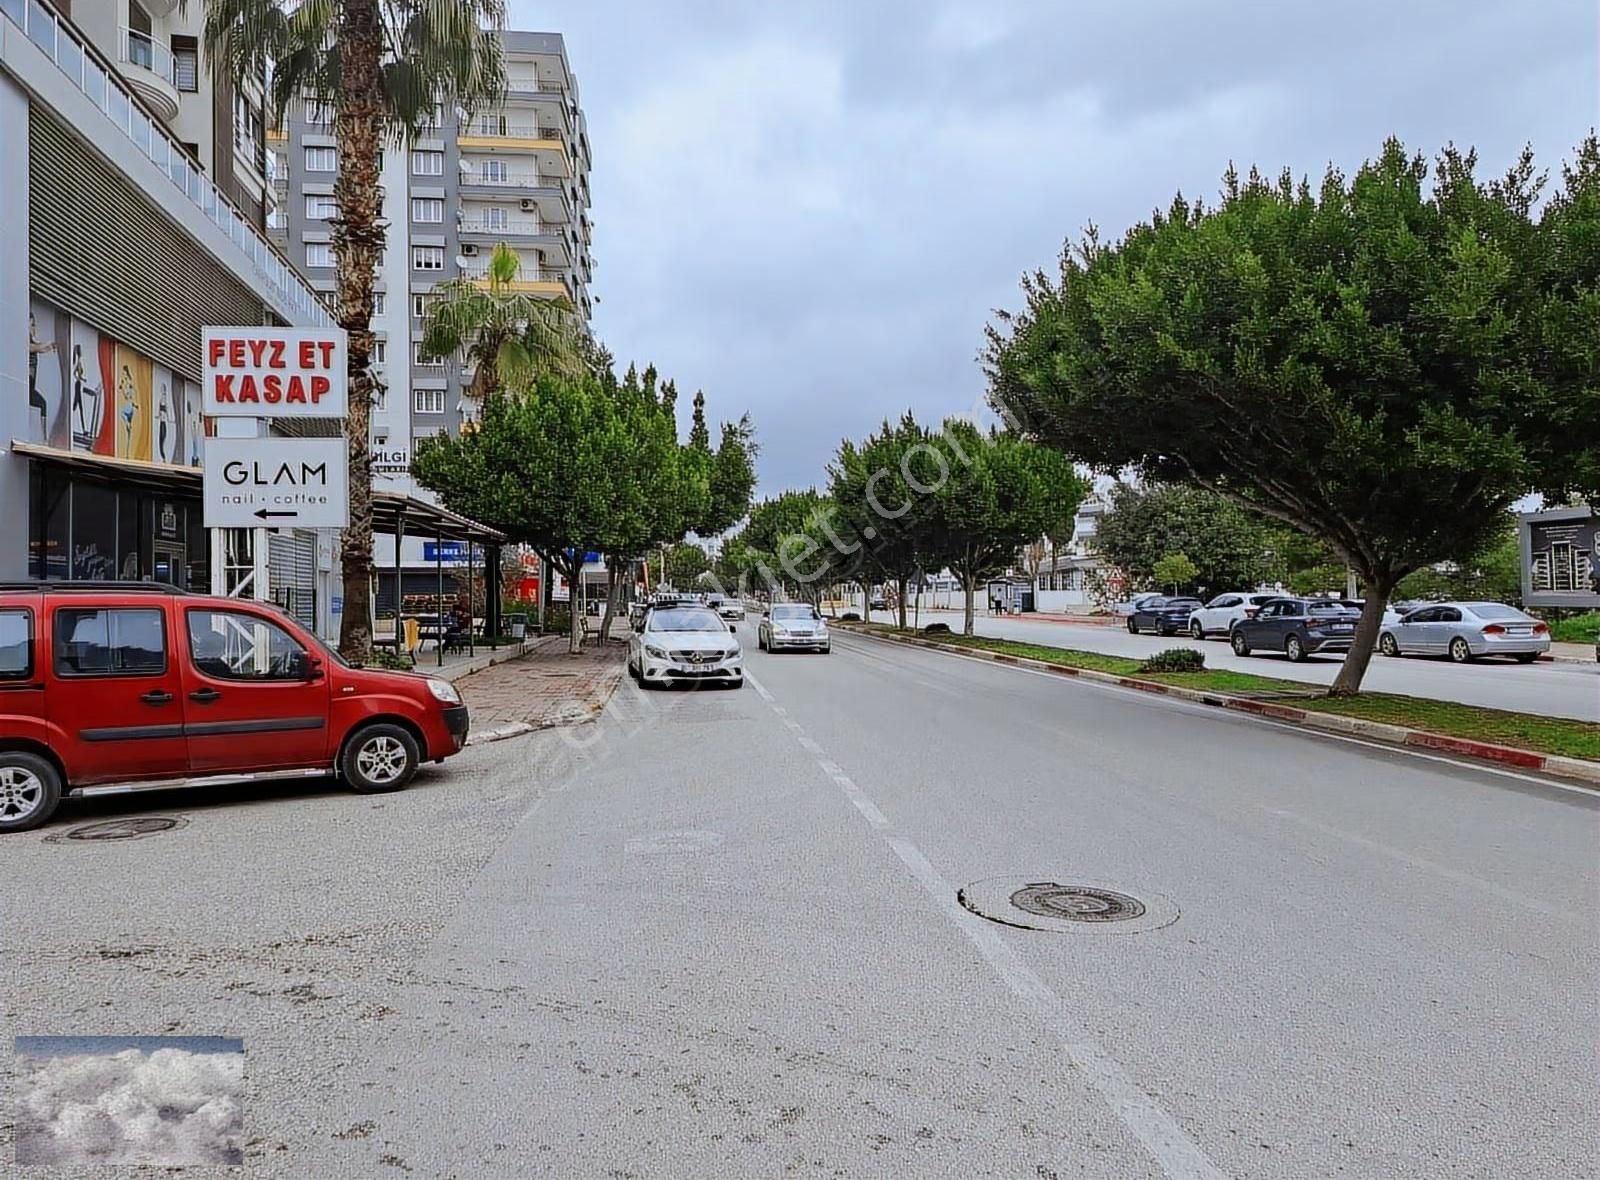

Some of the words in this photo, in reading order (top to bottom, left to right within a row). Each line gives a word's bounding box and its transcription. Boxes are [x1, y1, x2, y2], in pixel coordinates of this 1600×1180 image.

[209, 339, 286, 368] FEYZ
[299, 340, 336, 369] ET
[215, 374, 331, 404] KASAP
[223, 460, 327, 486] GLAM
[222, 493, 254, 505] nail
[274, 493, 328, 505] coffee
